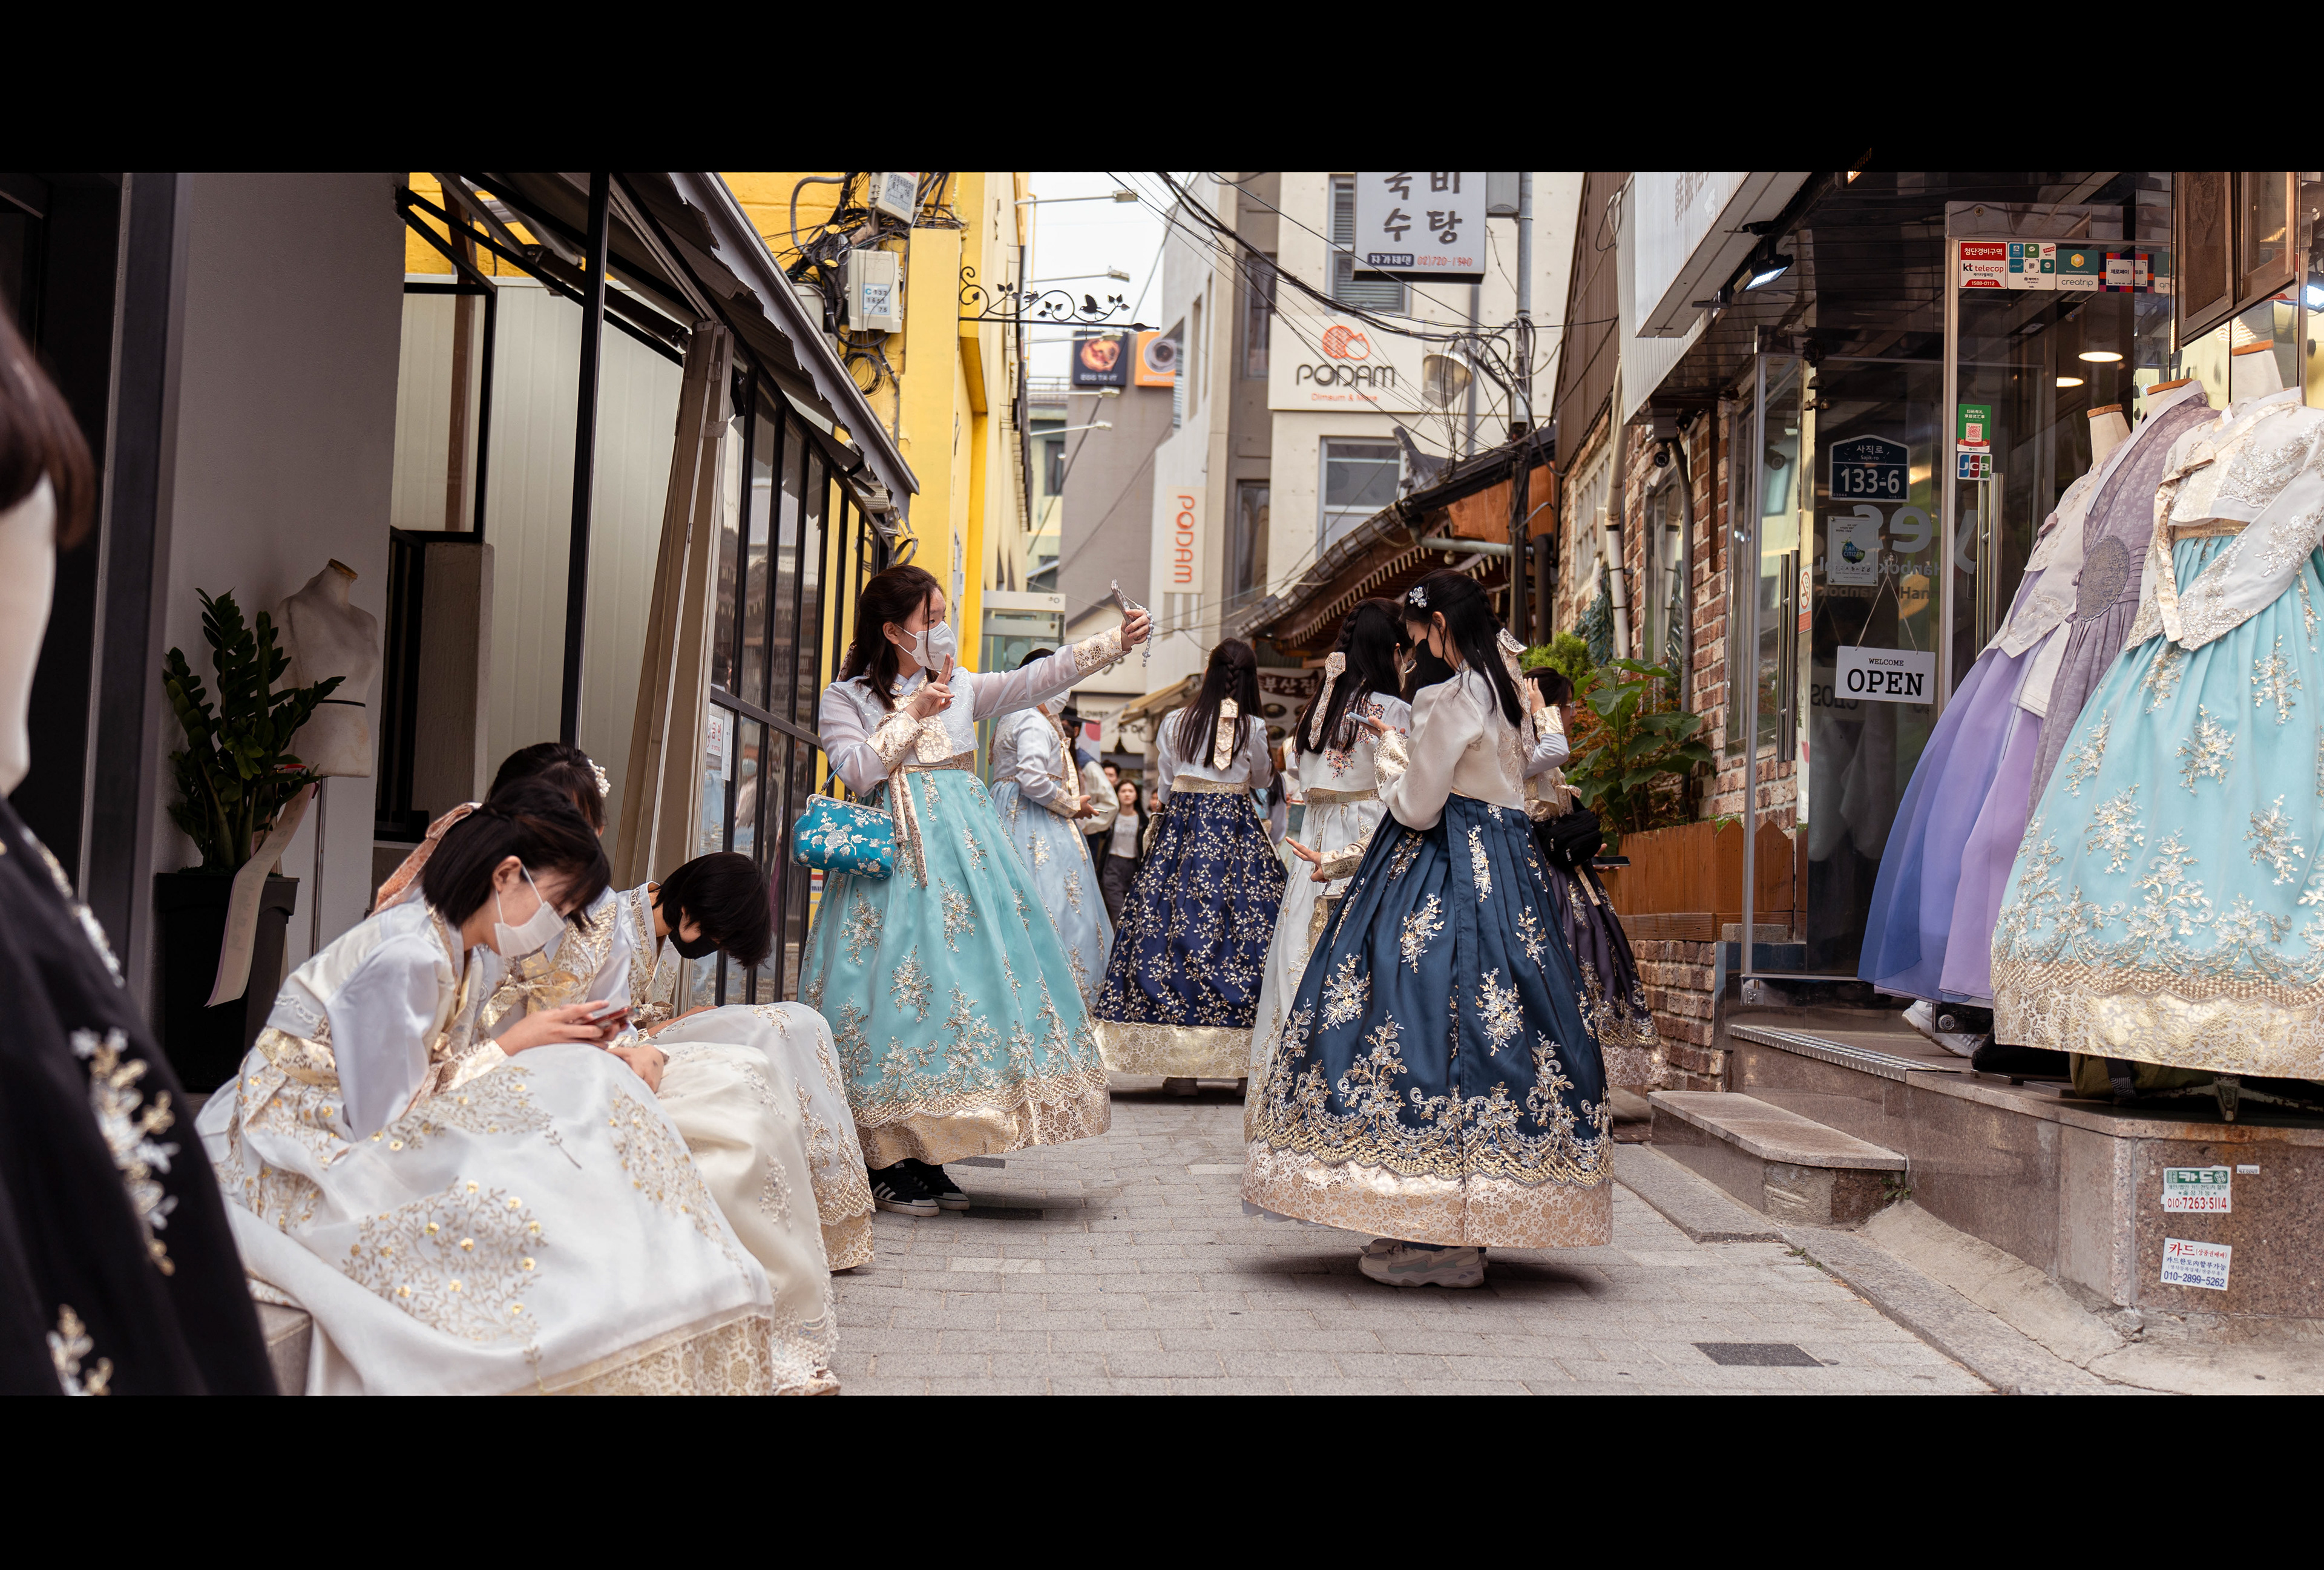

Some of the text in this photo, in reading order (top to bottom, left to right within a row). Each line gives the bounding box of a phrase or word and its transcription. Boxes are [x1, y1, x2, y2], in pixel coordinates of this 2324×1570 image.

[1963, 263, 2004, 274] kt telecop
[2061, 278, 2093, 287] creatrip
[1296, 364, 1394, 387] PODAM
[1856, 445, 1883, 455] 사직로
[1959, 462, 1989, 471] JCB
[1841, 468, 1900, 494] 133-6
[1174, 495, 1195, 583] PODAM
[1868, 658, 1904, 666] WELCOME
[1847, 669, 1924, 696] OPEN
[2179, 1171, 2213, 1183] 카드
[2168, 1242, 2195, 1256] 카드
[2164, 1270, 2225, 1287] 010-2899-5262
